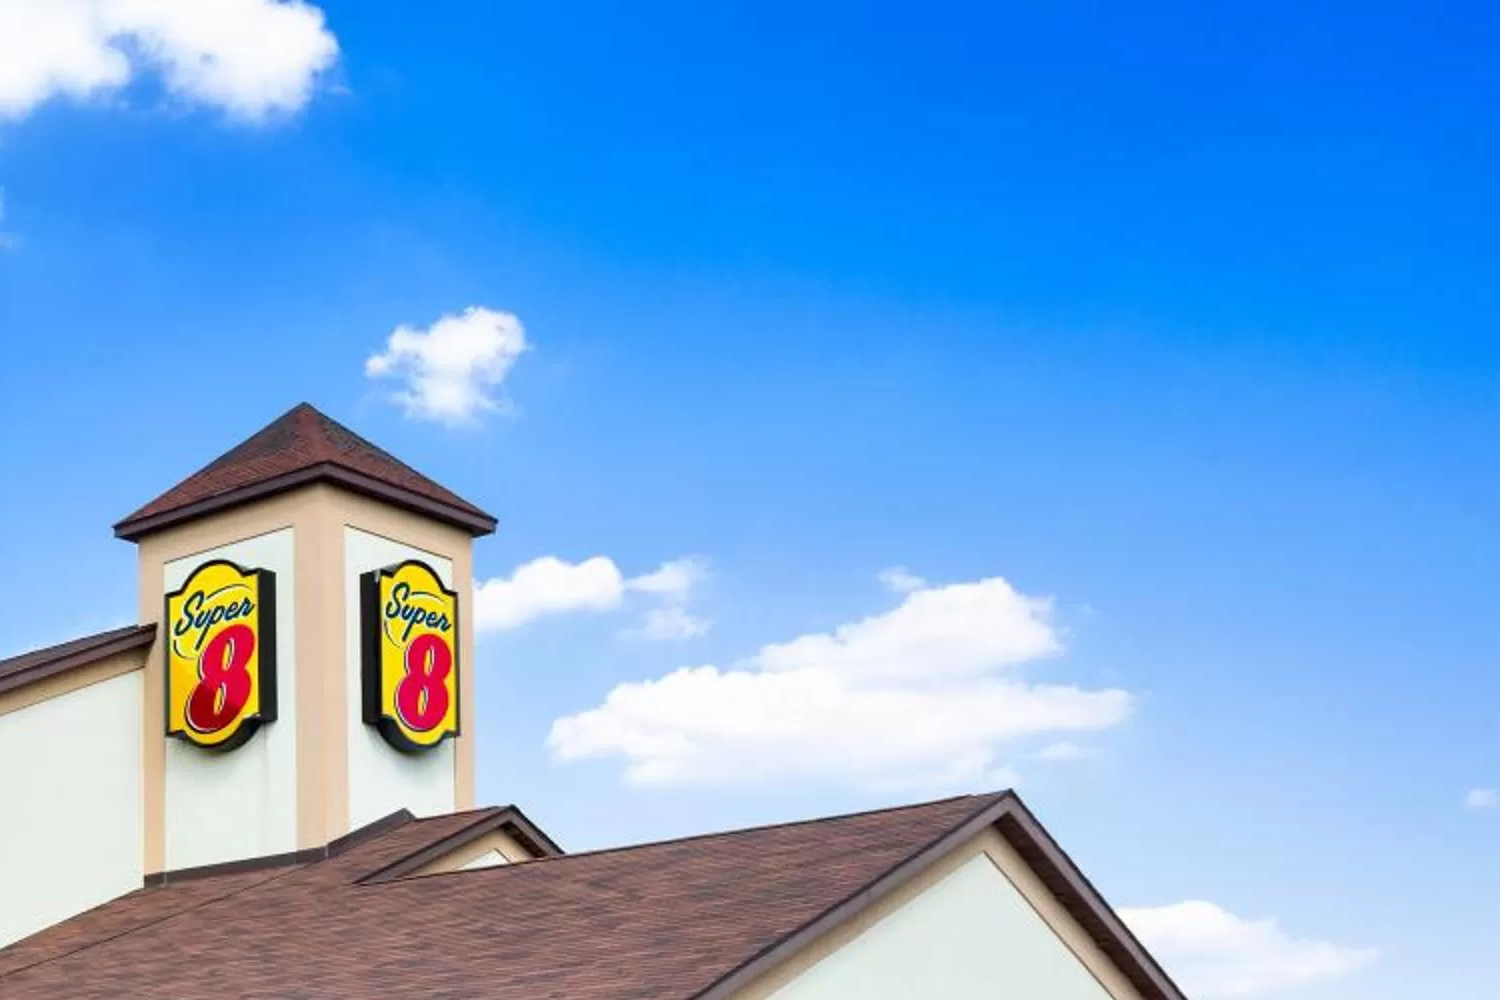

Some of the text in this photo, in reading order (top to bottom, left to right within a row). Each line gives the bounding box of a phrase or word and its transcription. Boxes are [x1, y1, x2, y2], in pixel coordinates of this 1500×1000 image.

[174, 590, 255, 650] Super
[386, 582, 452, 641] Super
[185, 624, 255, 733] 8
[394, 633, 452, 731] 8
